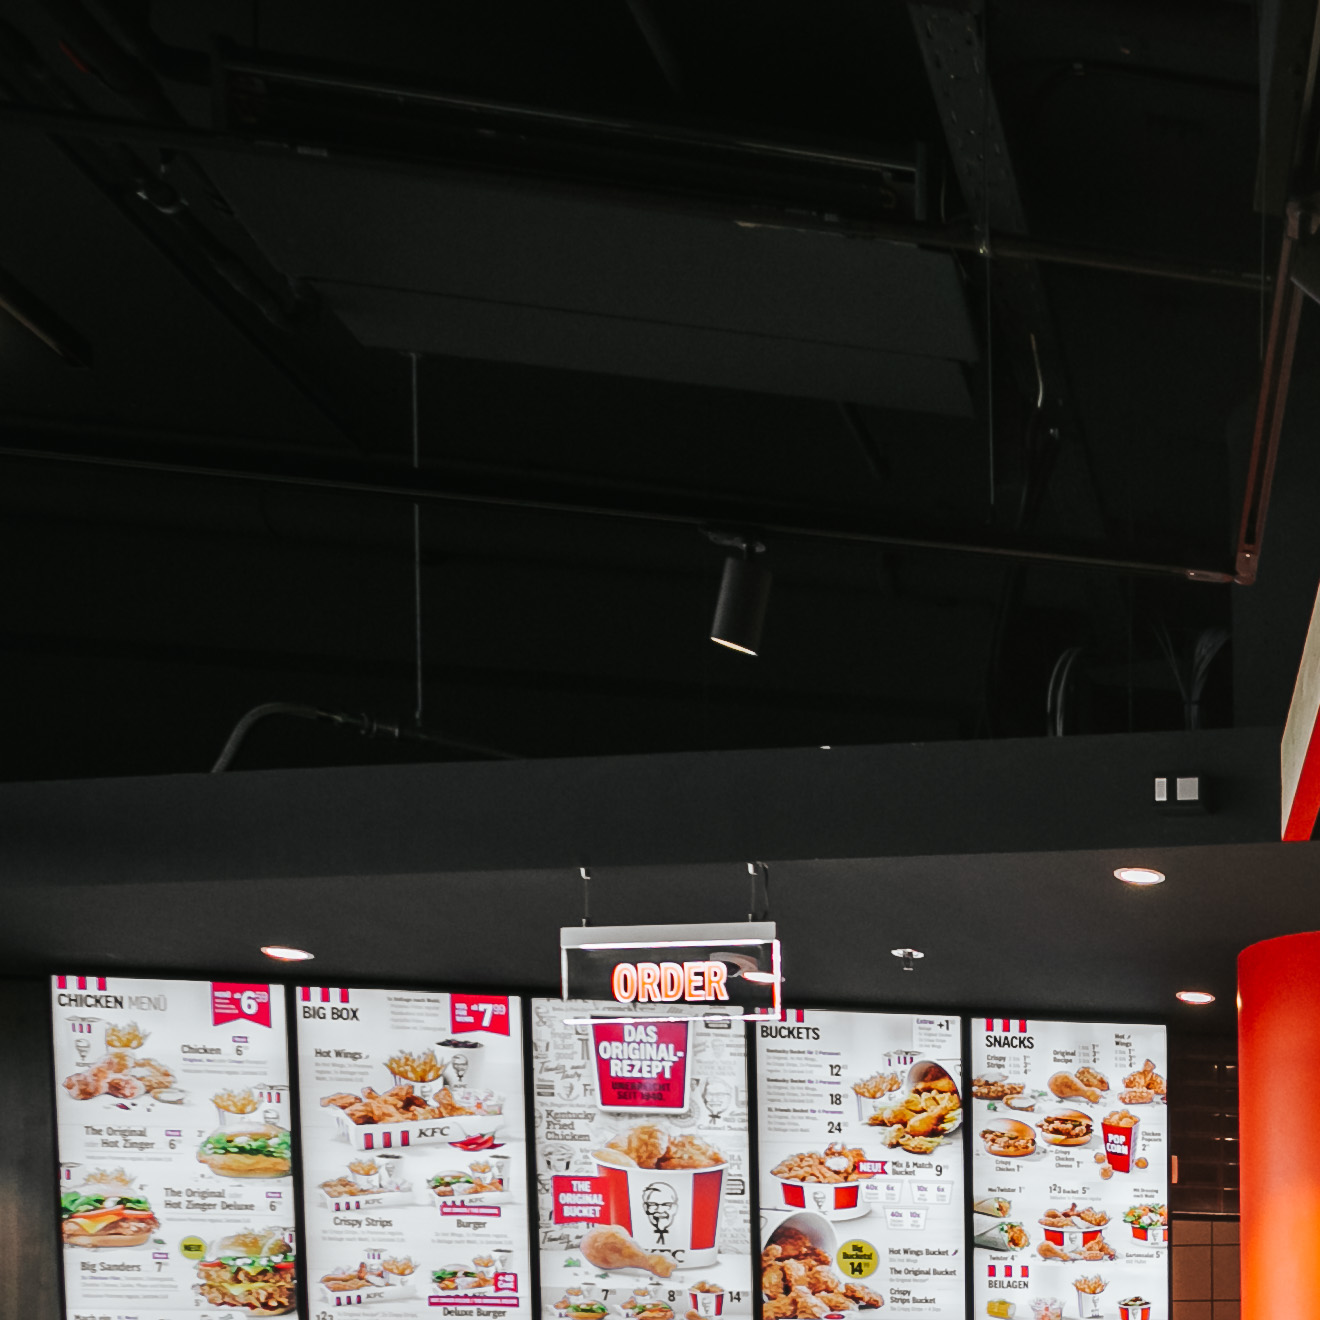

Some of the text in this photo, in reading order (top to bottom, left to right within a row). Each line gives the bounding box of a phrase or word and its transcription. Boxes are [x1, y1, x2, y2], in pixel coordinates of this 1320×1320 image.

[612, 961, 729, 1003] ORDER
[57, 993, 167, 1011] CHICKEN MENÜ
[302, 1006, 360, 1022] BIG BOX
[623, 1025, 658, 1042] DAS
[760, 1025, 820, 1040] BUCKETS
[985, 1034, 1034, 1049] SNACKS
[181, 1044, 222, 1055] Chicken
[314, 1049, 363, 1061] Hot Wings
[598, 1042, 684, 1061] ORIGINAL-
[1052, 1049, 1076, 1058] Original
[986, 1054, 1006, 1063] Crispy
[610, 1060, 673, 1079] REZEPT
[617, 1091, 637, 1100] SEIT
[545, 1110, 596, 1122] Kentucky
[545, 1120, 575, 1130] Fried
[84, 1126, 147, 1138] The Original
[417, 1126, 450, 1139] KFC
[545, 1131, 591, 1141] Chicken
[1107, 1133, 1126, 1144] POP
[101, 1139, 155, 1151] Hot Zinger
[1106, 1143, 1129, 1155] CORN
[859, 1162, 882, 1173] NEU!
[913, 1161, 933, 1169] Match
[892, 1168, 916, 1176] Bucket
[571, 1181, 591, 1192] THE
[164, 1188, 225, 1200] The Original
[558, 1193, 605, 1205] ORIGINAL
[164, 1200, 255, 1211] Hot Zinger Deluxe
[563, 1206, 601, 1218] BUCKET
[333, 1217, 393, 1229] Crispy Strips
[457, 1219, 487, 1230] Burger
[888, 1248, 901, 1256] Hot
[904, 1248, 923, 1258] Wings
[81, 1262, 141, 1273] Big Sanders
[889, 1267, 957, 1277] The Original Bucket
[988, 1280, 1029, 1289] BEILAGEN
[889, 1288, 911, 1297] Crispy
[890, 1296, 936, 1305] Strips Bucket
[443, 1307, 507, 1319] Deluxe Burger
